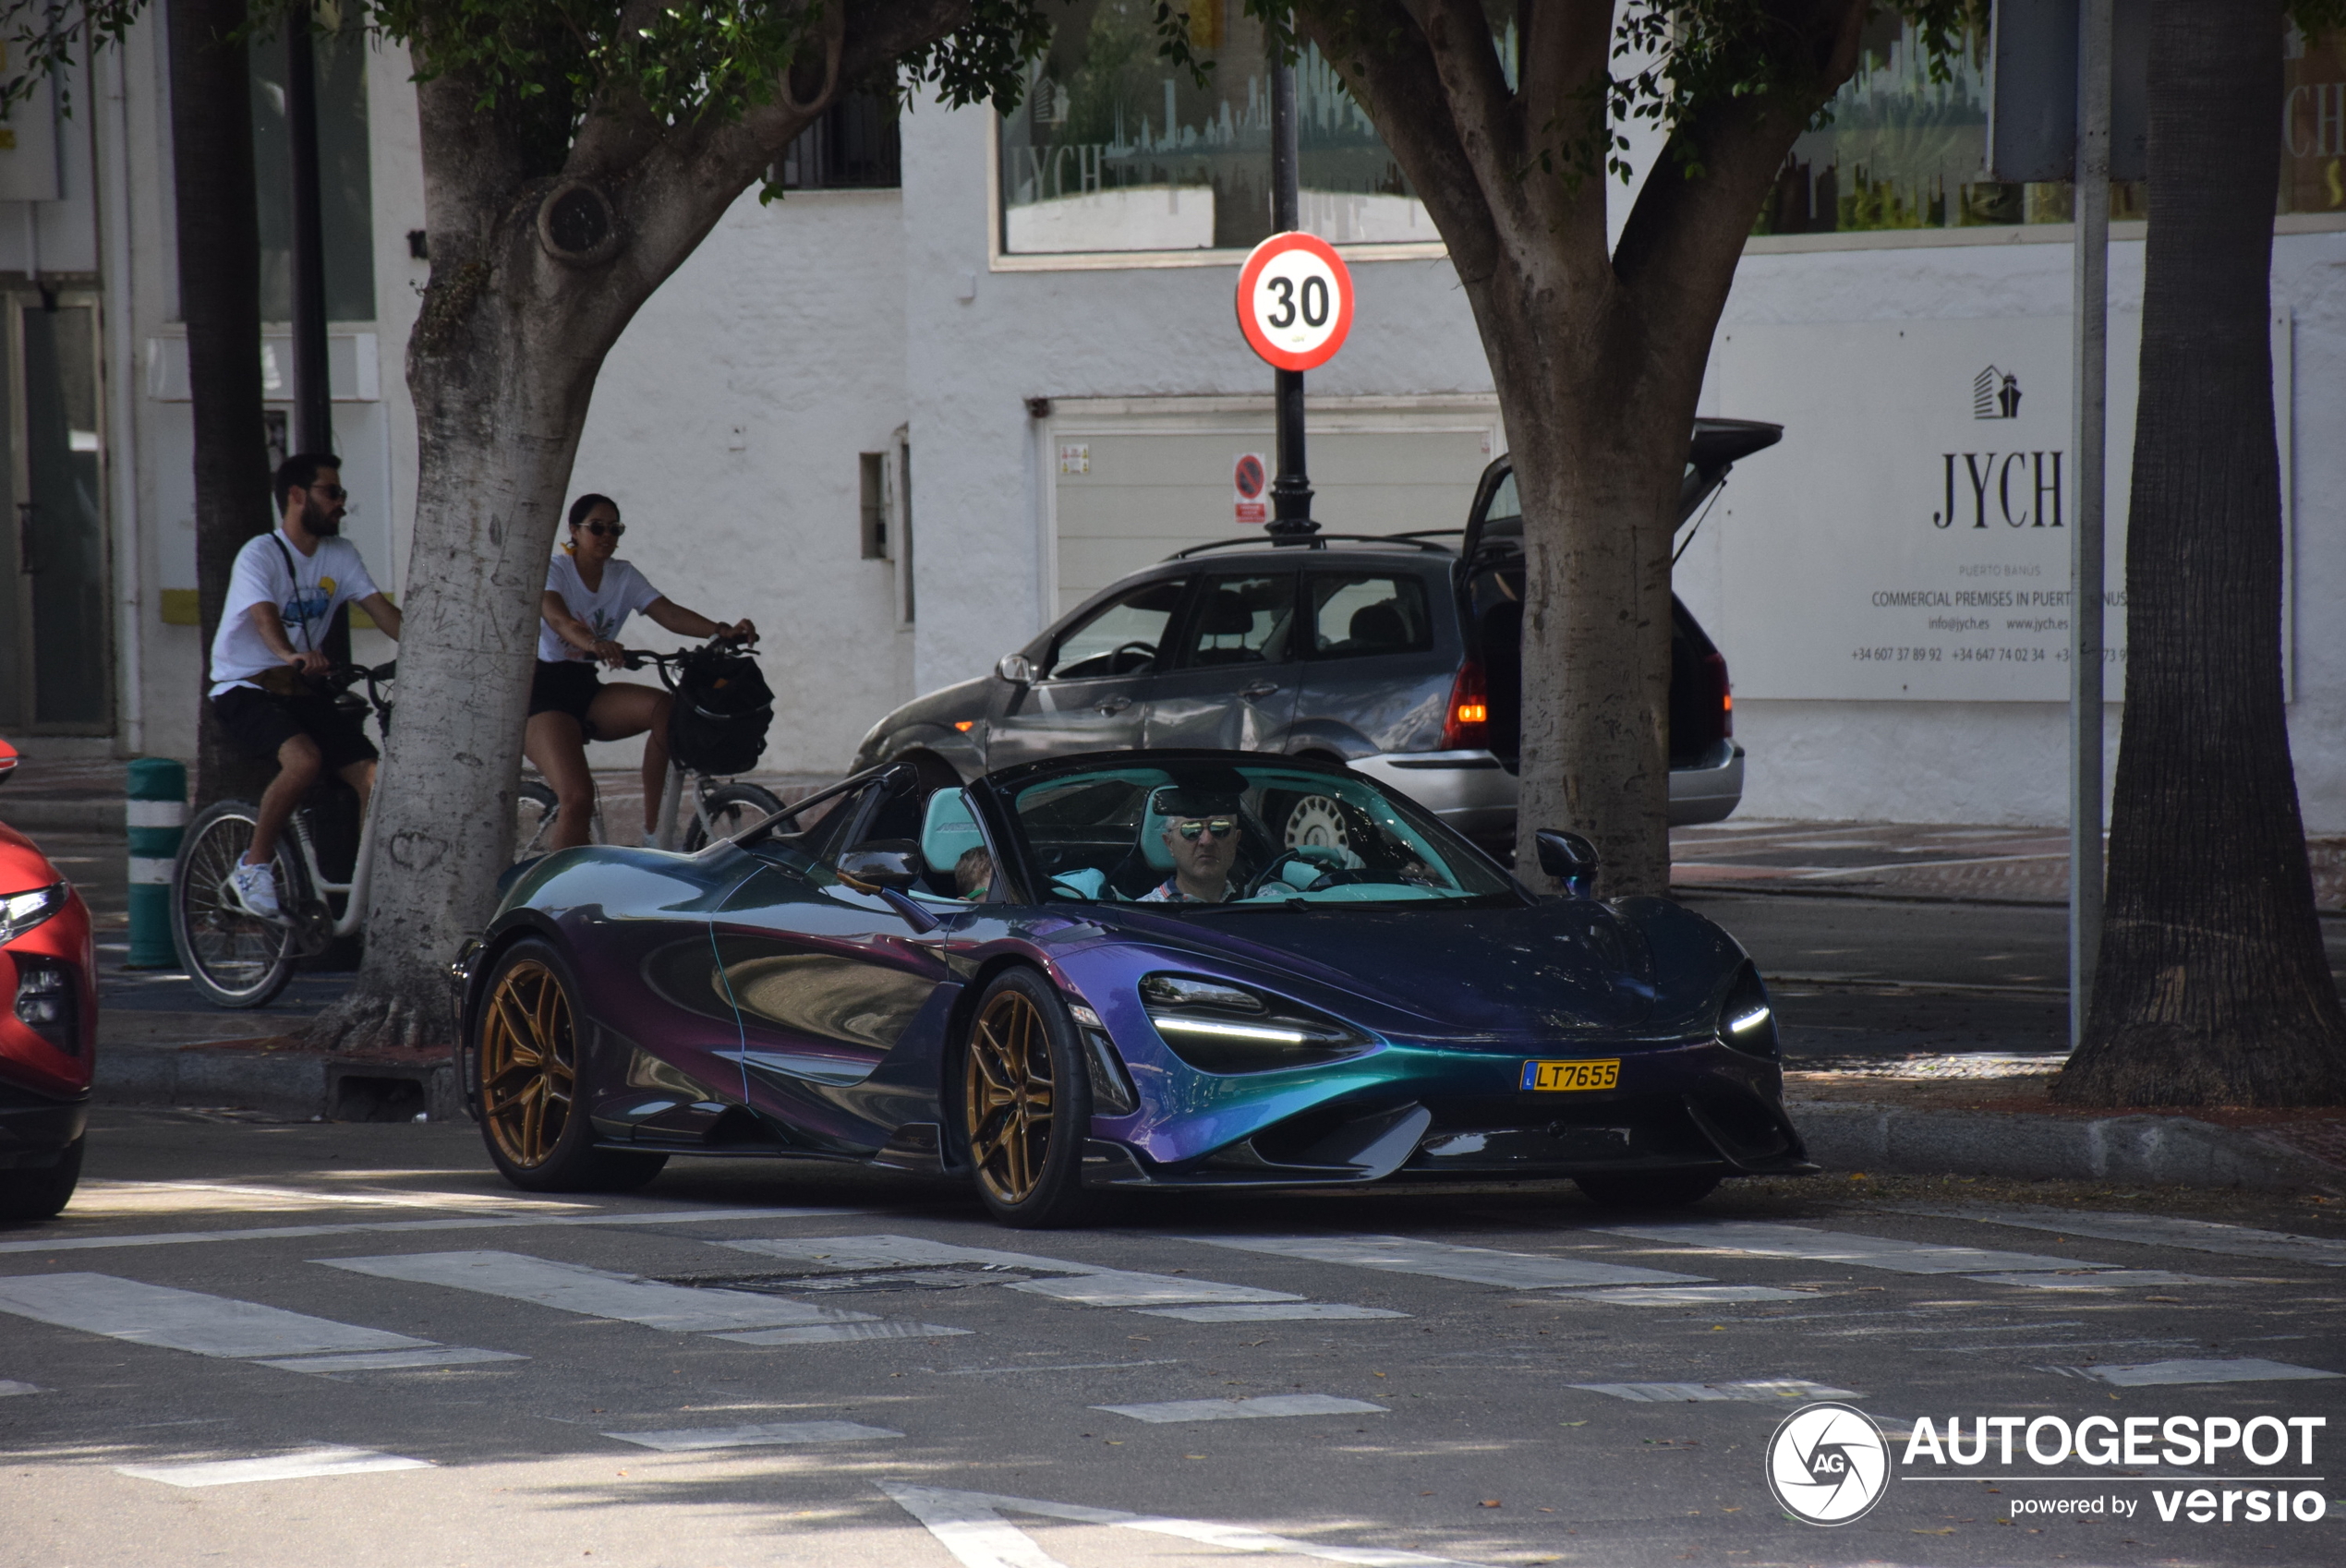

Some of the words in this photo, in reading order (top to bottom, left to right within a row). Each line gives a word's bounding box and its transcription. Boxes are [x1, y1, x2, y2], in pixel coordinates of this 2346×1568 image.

[2282, 83, 2346, 157] CH
[1267, 275, 1329, 329] 30
[1933, 451, 2064, 529] JYCH
[1959, 563, 2001, 577] PUERTO
[1872, 590, 1951, 607] COMMERCIAL
[1955, 590, 2013, 607] PREMISES
[2016, 590, 2029, 607] IN
[2033, 590, 2072, 607] PUERT
[2104, 590, 2128, 607] NUS
[1929, 614, 1989, 633] info@jych.es
[2006, 616, 2069, 633] www.jych.es
[1851, 647, 1871, 660] +34
[1873, 646, 1893, 660] 607
[1896, 646, 1909, 660] 37
[1912, 646, 1926, 660] 89
[1929, 646, 1942, 660] 92
[1952, 647, 1972, 660] +34
[1976, 647, 1995, 660] 647
[1999, 647, 2012, 660] 74
[2014, 647, 2028, 660] 02
[2031, 647, 2044, 660] 34
[2055, 648, 2069, 660] +3
[1526, 1078, 1531, 1086] L
[1537, 1065, 1617, 1087] LT7655
